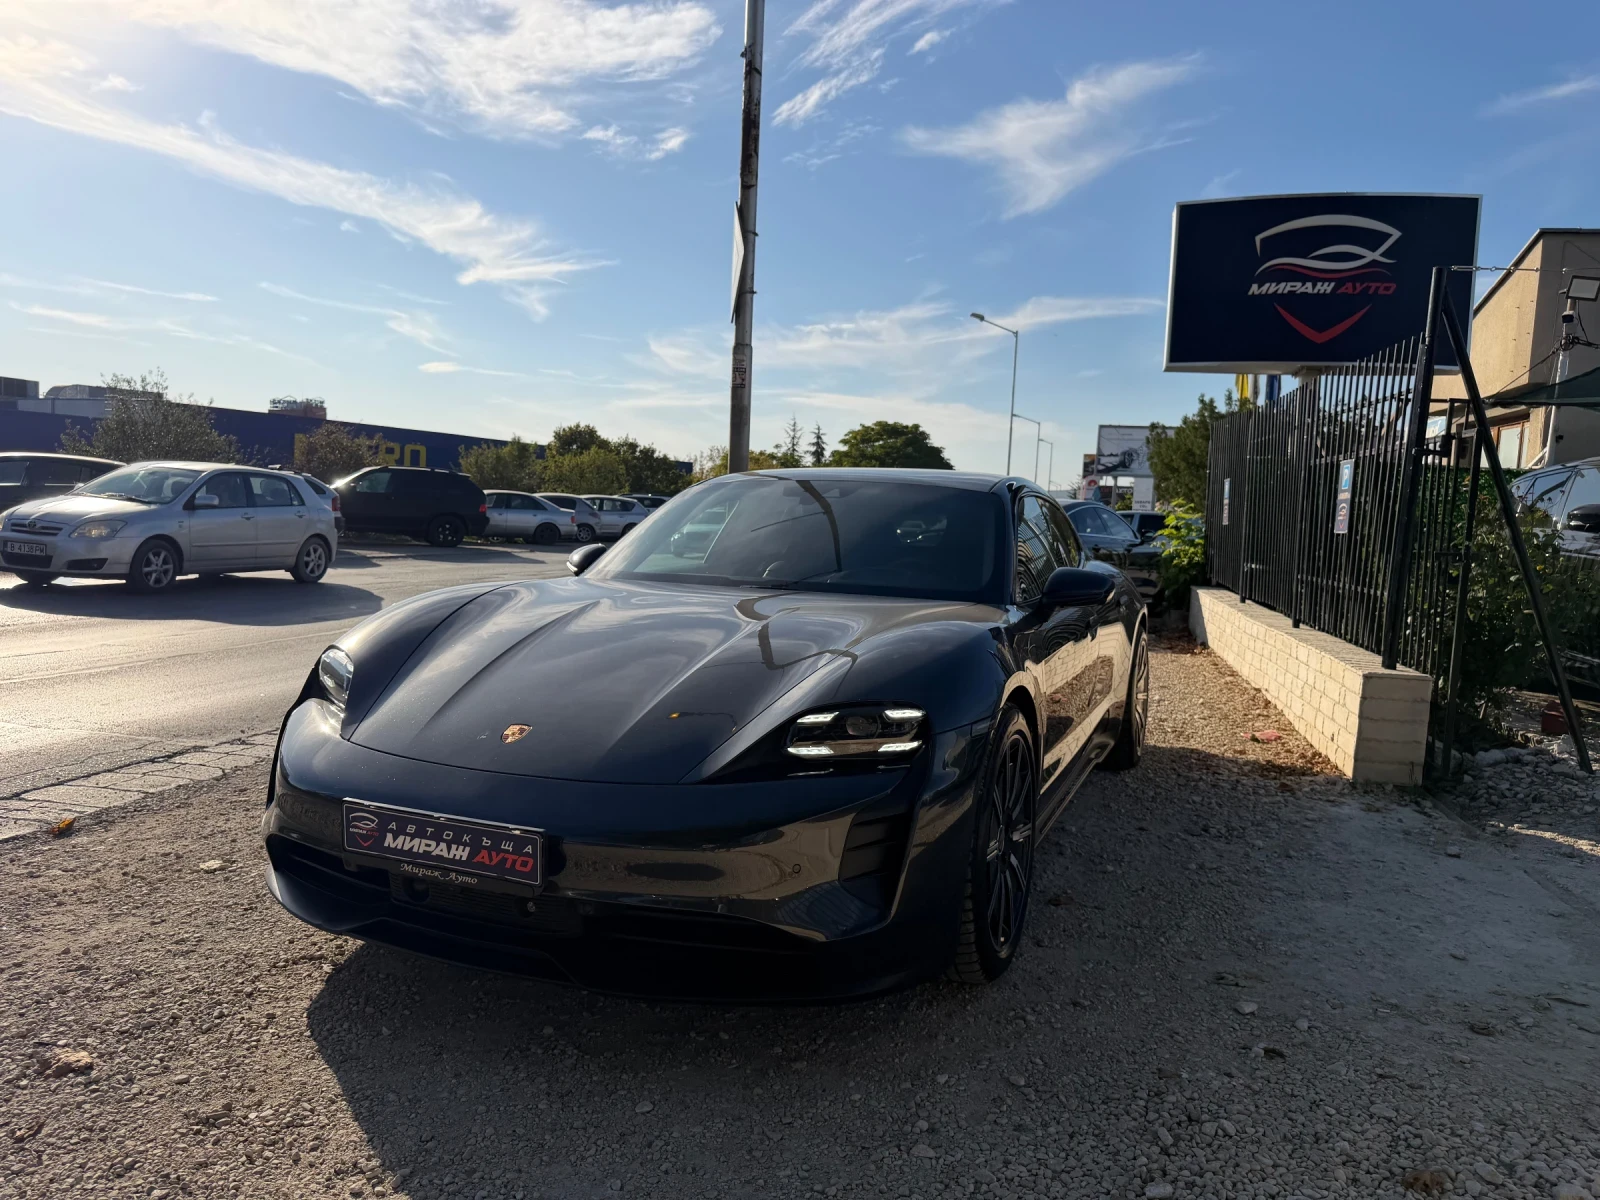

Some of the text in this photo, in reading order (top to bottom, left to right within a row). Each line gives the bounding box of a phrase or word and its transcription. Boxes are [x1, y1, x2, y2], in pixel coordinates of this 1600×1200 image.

[1248, 282, 1397, 295] МИРАЖ АУТО
[388, 821, 533, 854] АВТОКЪЩА
[384, 833, 534, 873] МИРАЖ АУТО
[400, 863, 478, 885] Мираж Ауто
